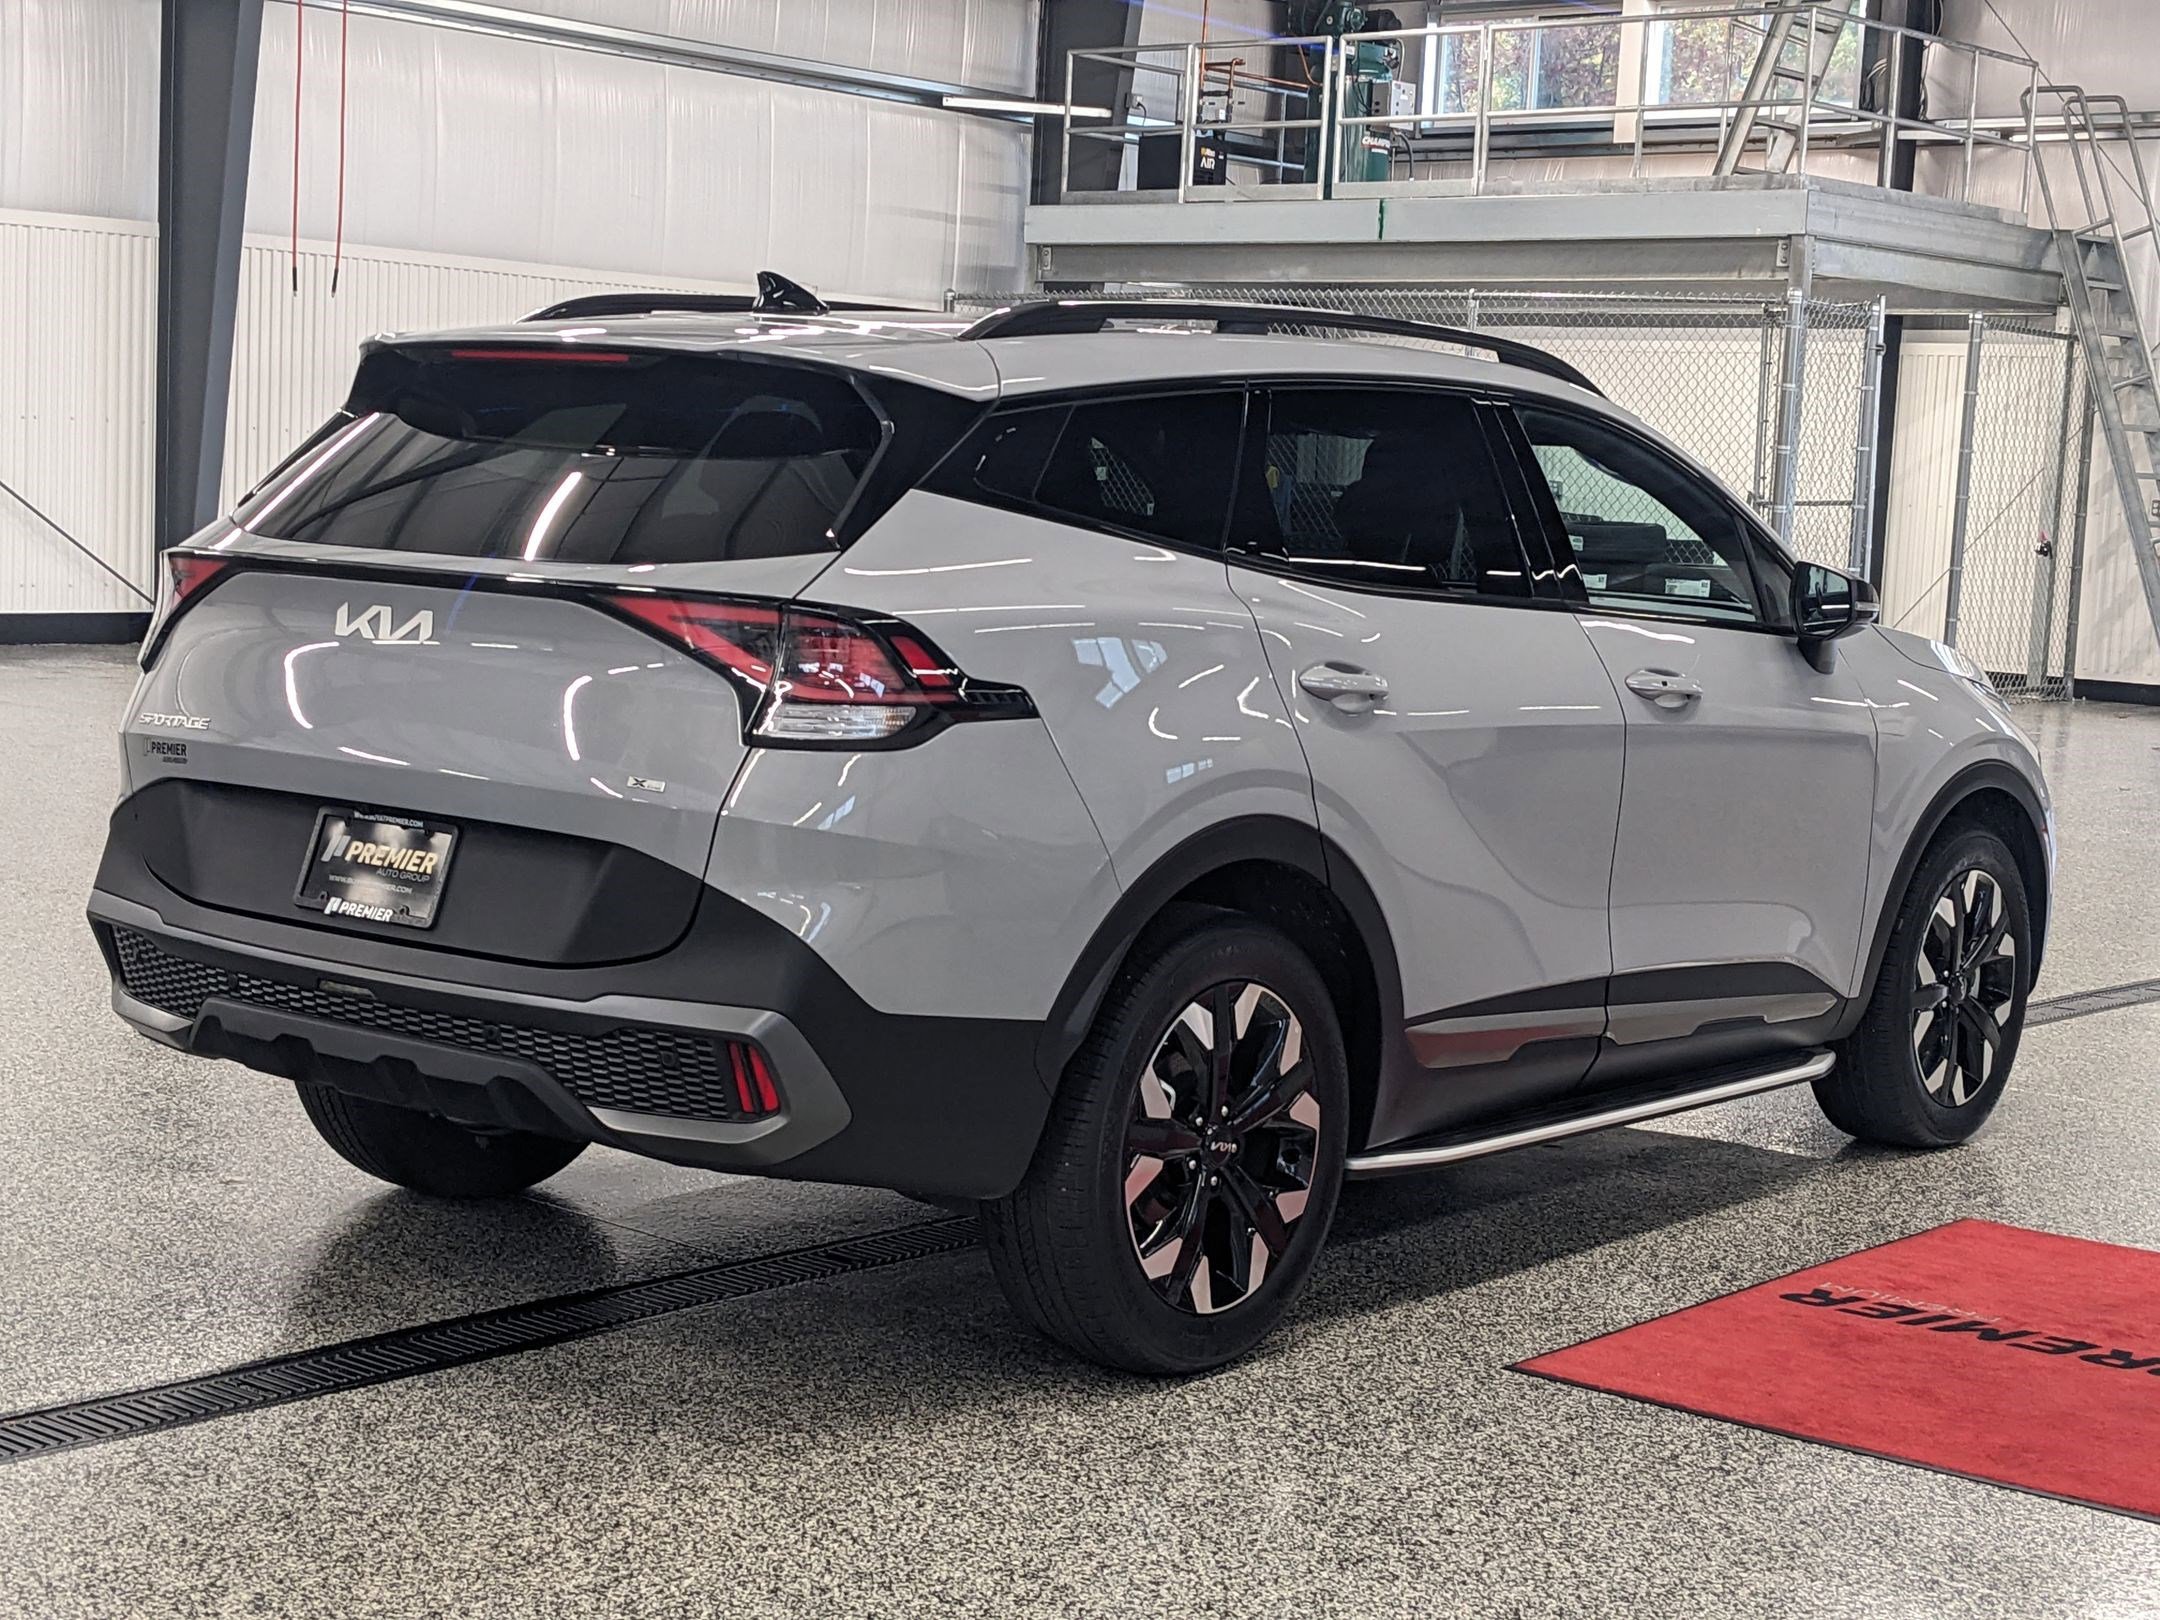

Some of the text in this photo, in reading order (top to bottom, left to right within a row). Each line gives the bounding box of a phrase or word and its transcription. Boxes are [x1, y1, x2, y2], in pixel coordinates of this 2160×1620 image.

[1200, 157, 1216, 170] AIR
[334, 601, 434, 642] KIA
[139, 712, 211, 730] SPORTAGE
[151, 741, 187, 757] PREMIER
[344, 840, 438, 874] PREMIER
[375, 868, 431, 883] AUTO GROUP
[338, 901, 394, 922] PREMIER
